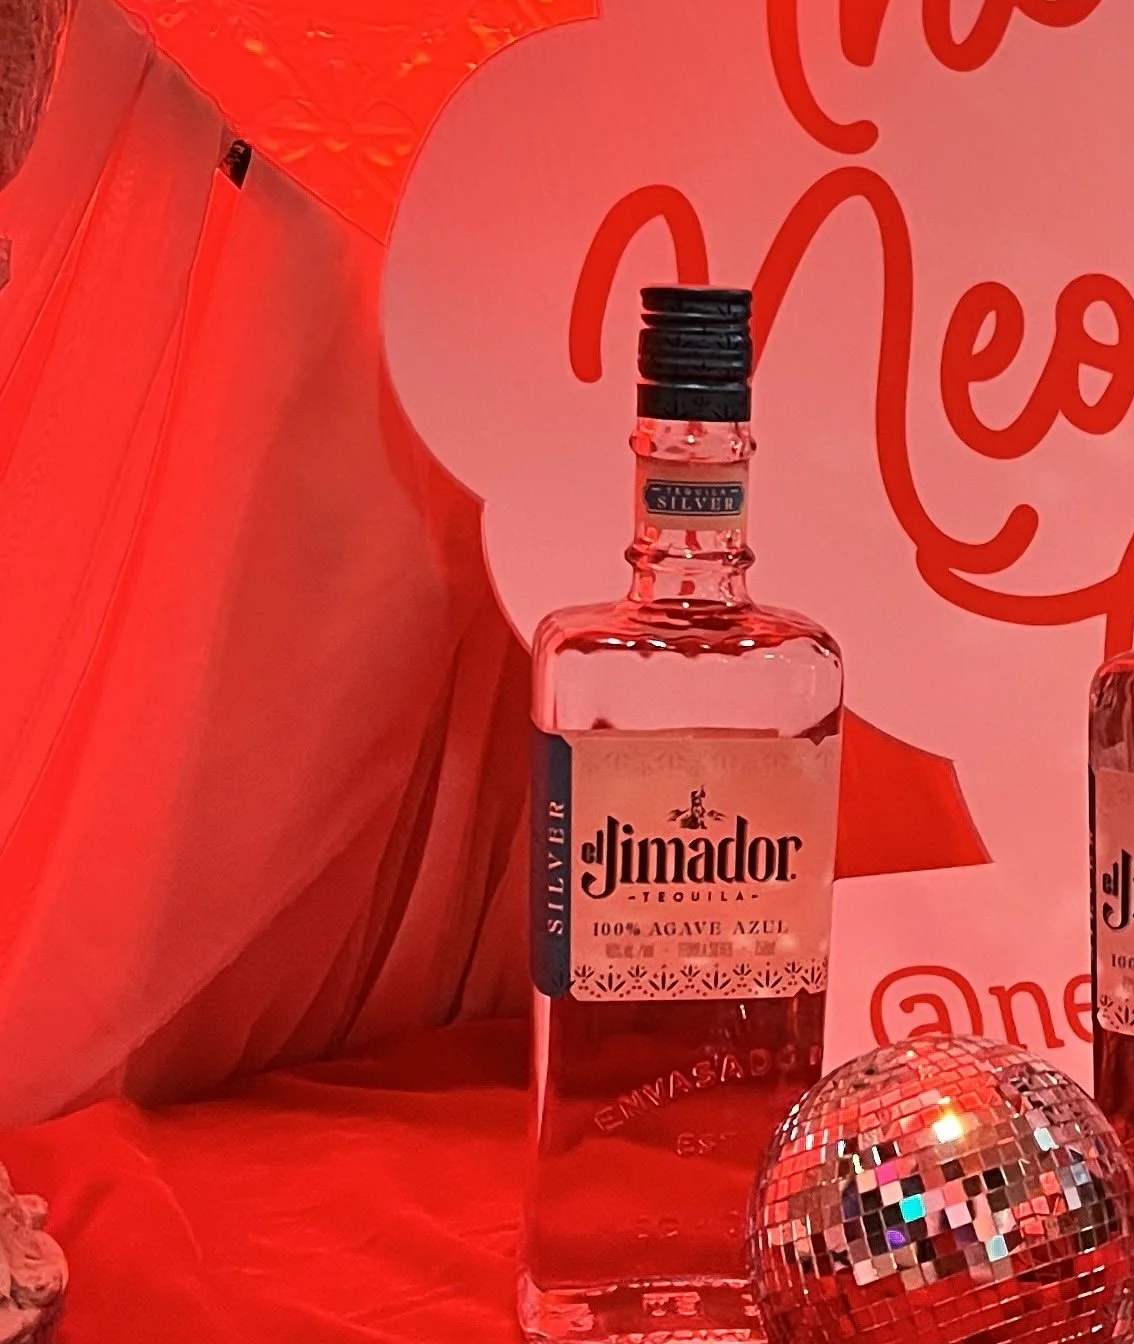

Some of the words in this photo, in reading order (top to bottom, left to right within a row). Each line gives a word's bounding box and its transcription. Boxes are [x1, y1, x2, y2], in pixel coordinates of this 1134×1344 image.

[656, 496, 735, 511] SILVER
[547, 801, 566, 935] SILVER
[592, 920, 641, 937] 100%
[648, 919, 722, 937] AGAVE
[732, 918, 790, 936] AZUL
